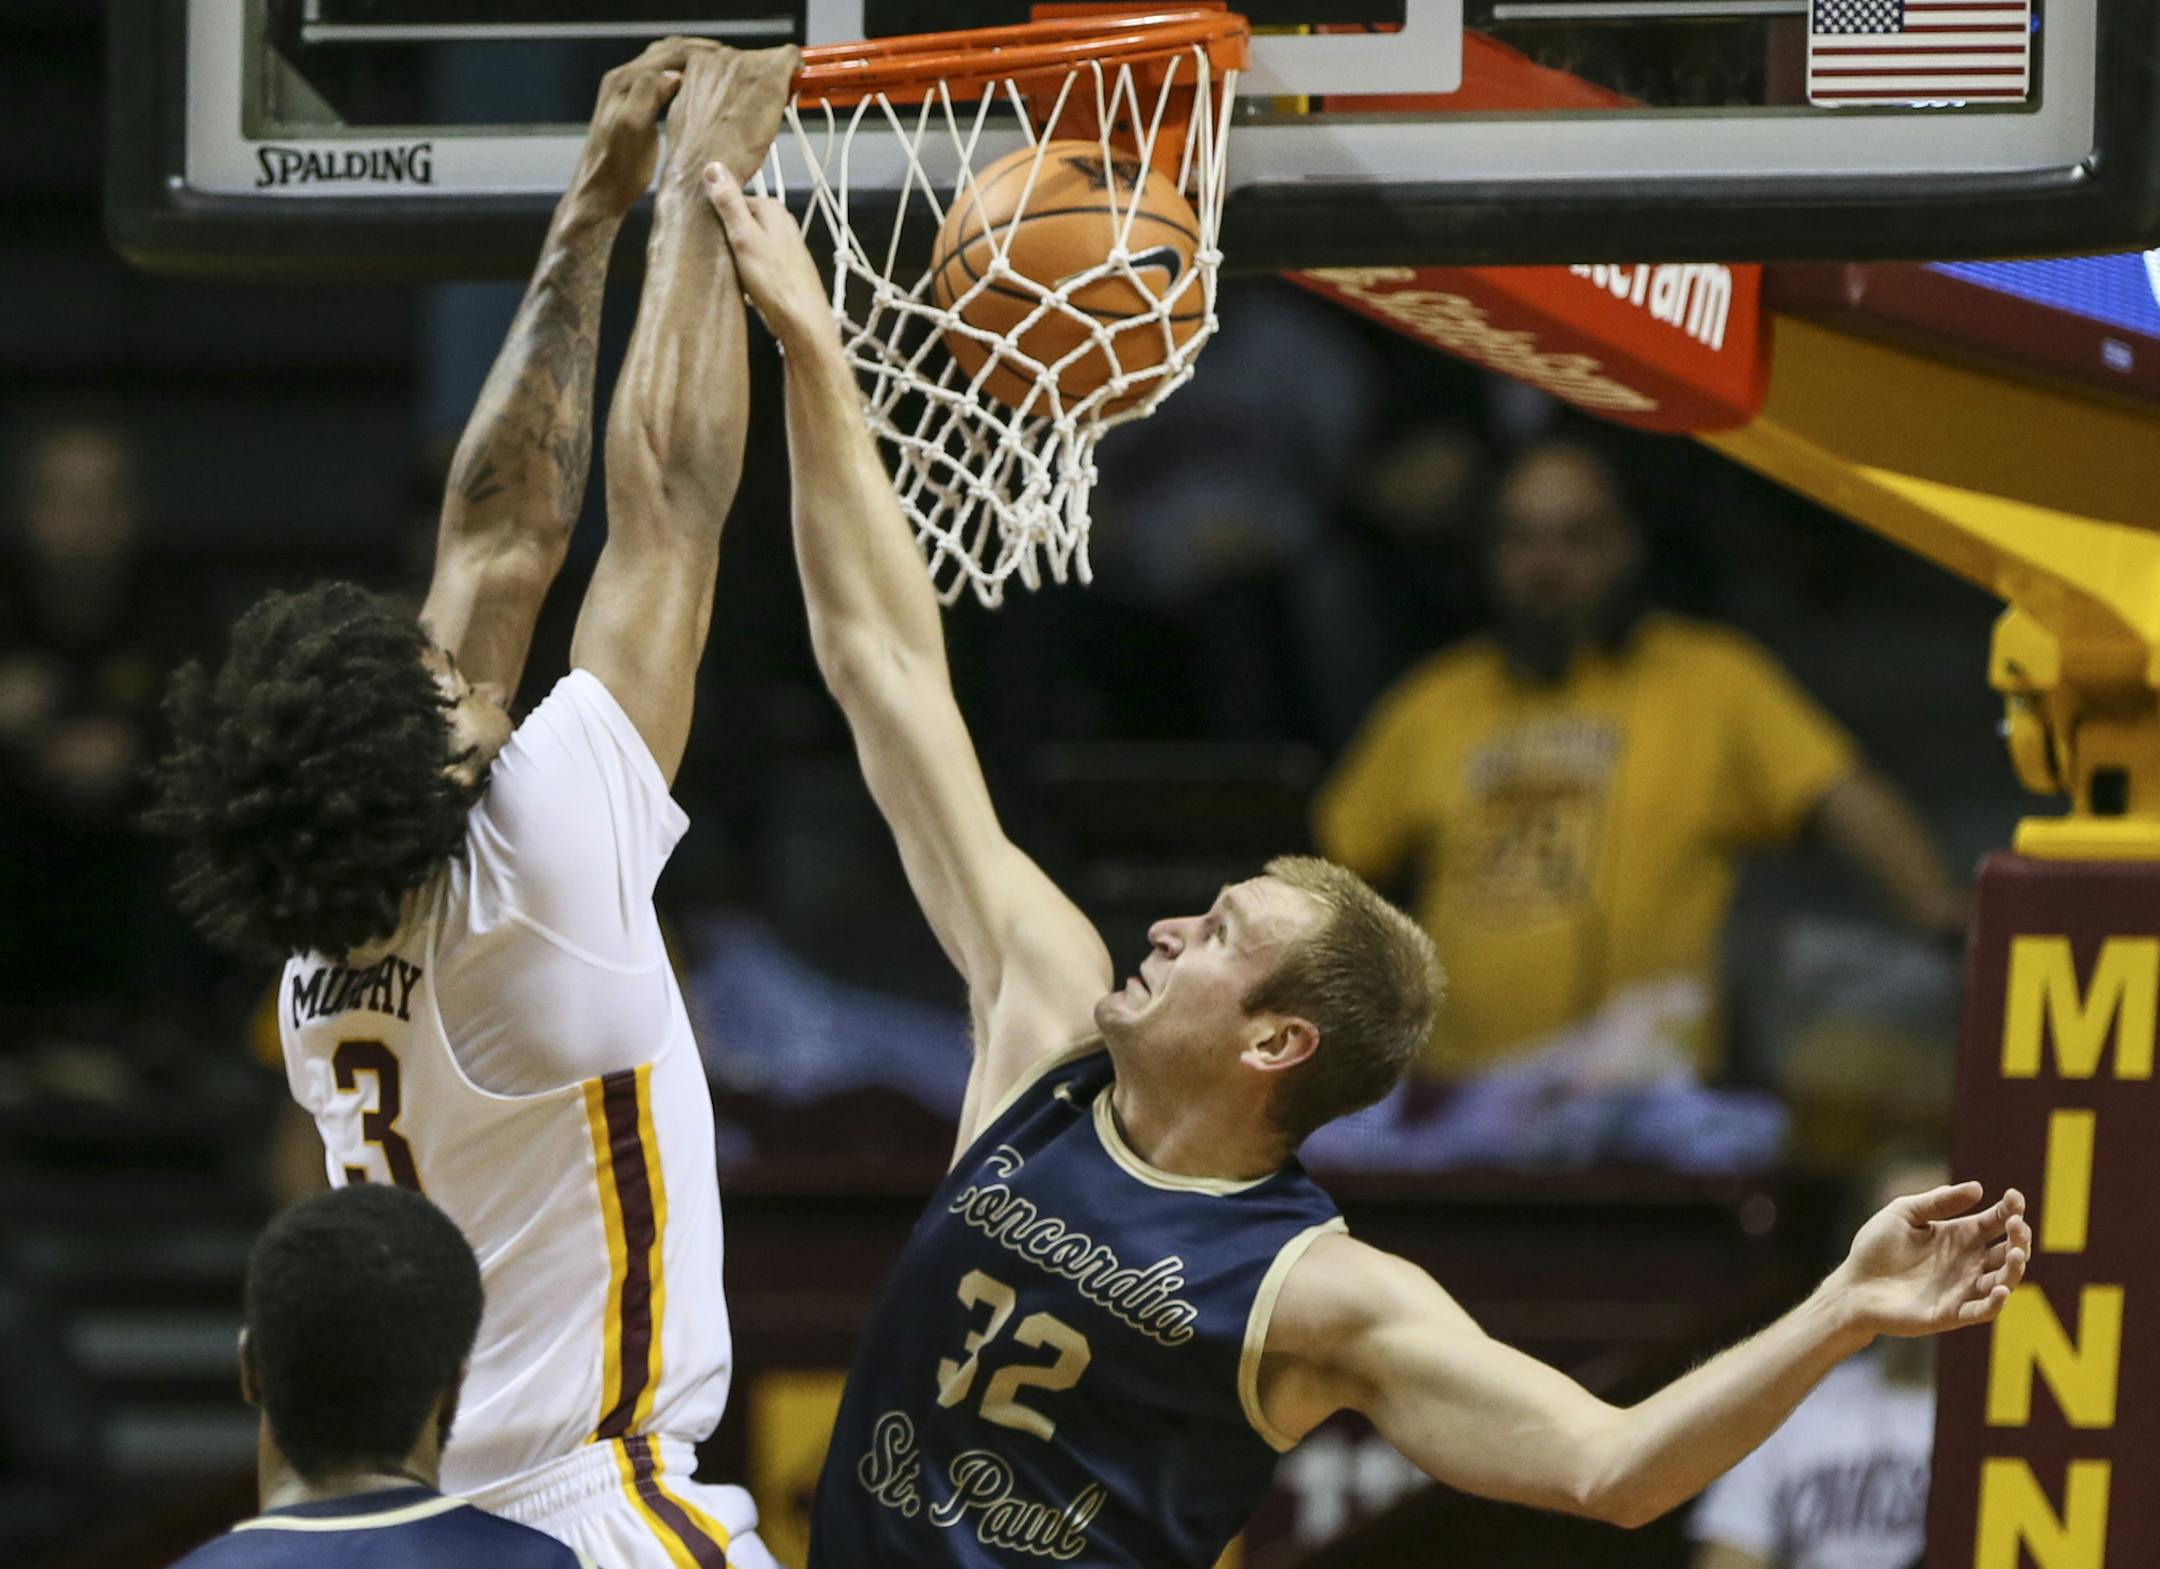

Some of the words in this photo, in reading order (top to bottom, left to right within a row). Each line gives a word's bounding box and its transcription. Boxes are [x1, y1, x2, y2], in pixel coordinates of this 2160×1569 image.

[256, 141, 434, 188] SPALDING
[293, 954, 423, 1029] MUPHY
[332, 1039, 428, 1200] 3
[948, 1144, 1198, 1345] Concordia
[936, 1268, 1092, 1442] 32
[858, 1410, 921, 1517] St.
[929, 1449, 1108, 1559] Paul
